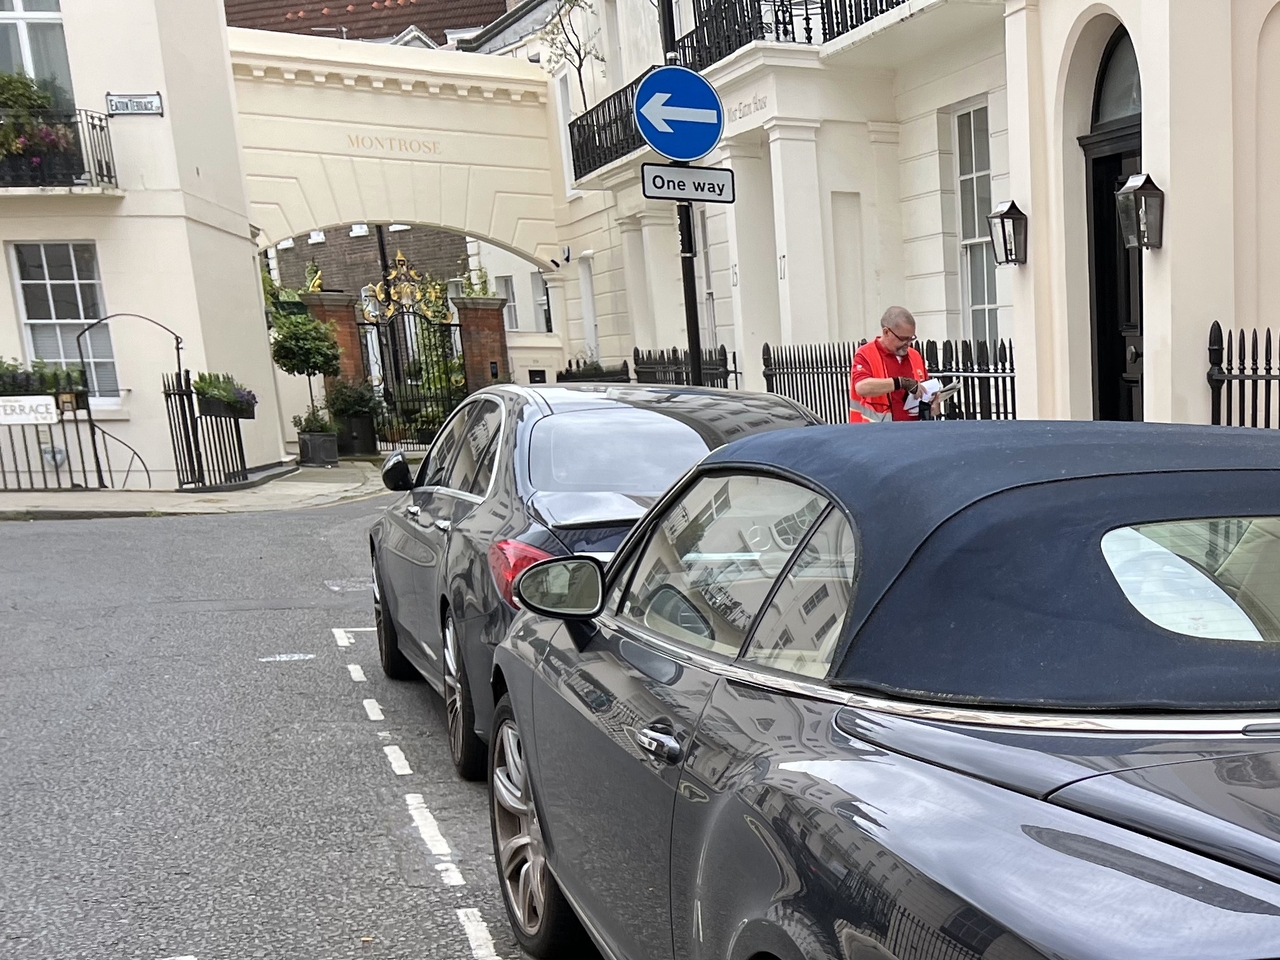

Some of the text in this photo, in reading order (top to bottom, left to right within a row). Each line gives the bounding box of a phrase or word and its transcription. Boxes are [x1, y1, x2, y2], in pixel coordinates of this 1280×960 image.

[347, 134, 441, 155] MONTROSE
[652, 174, 725, 196] One way
